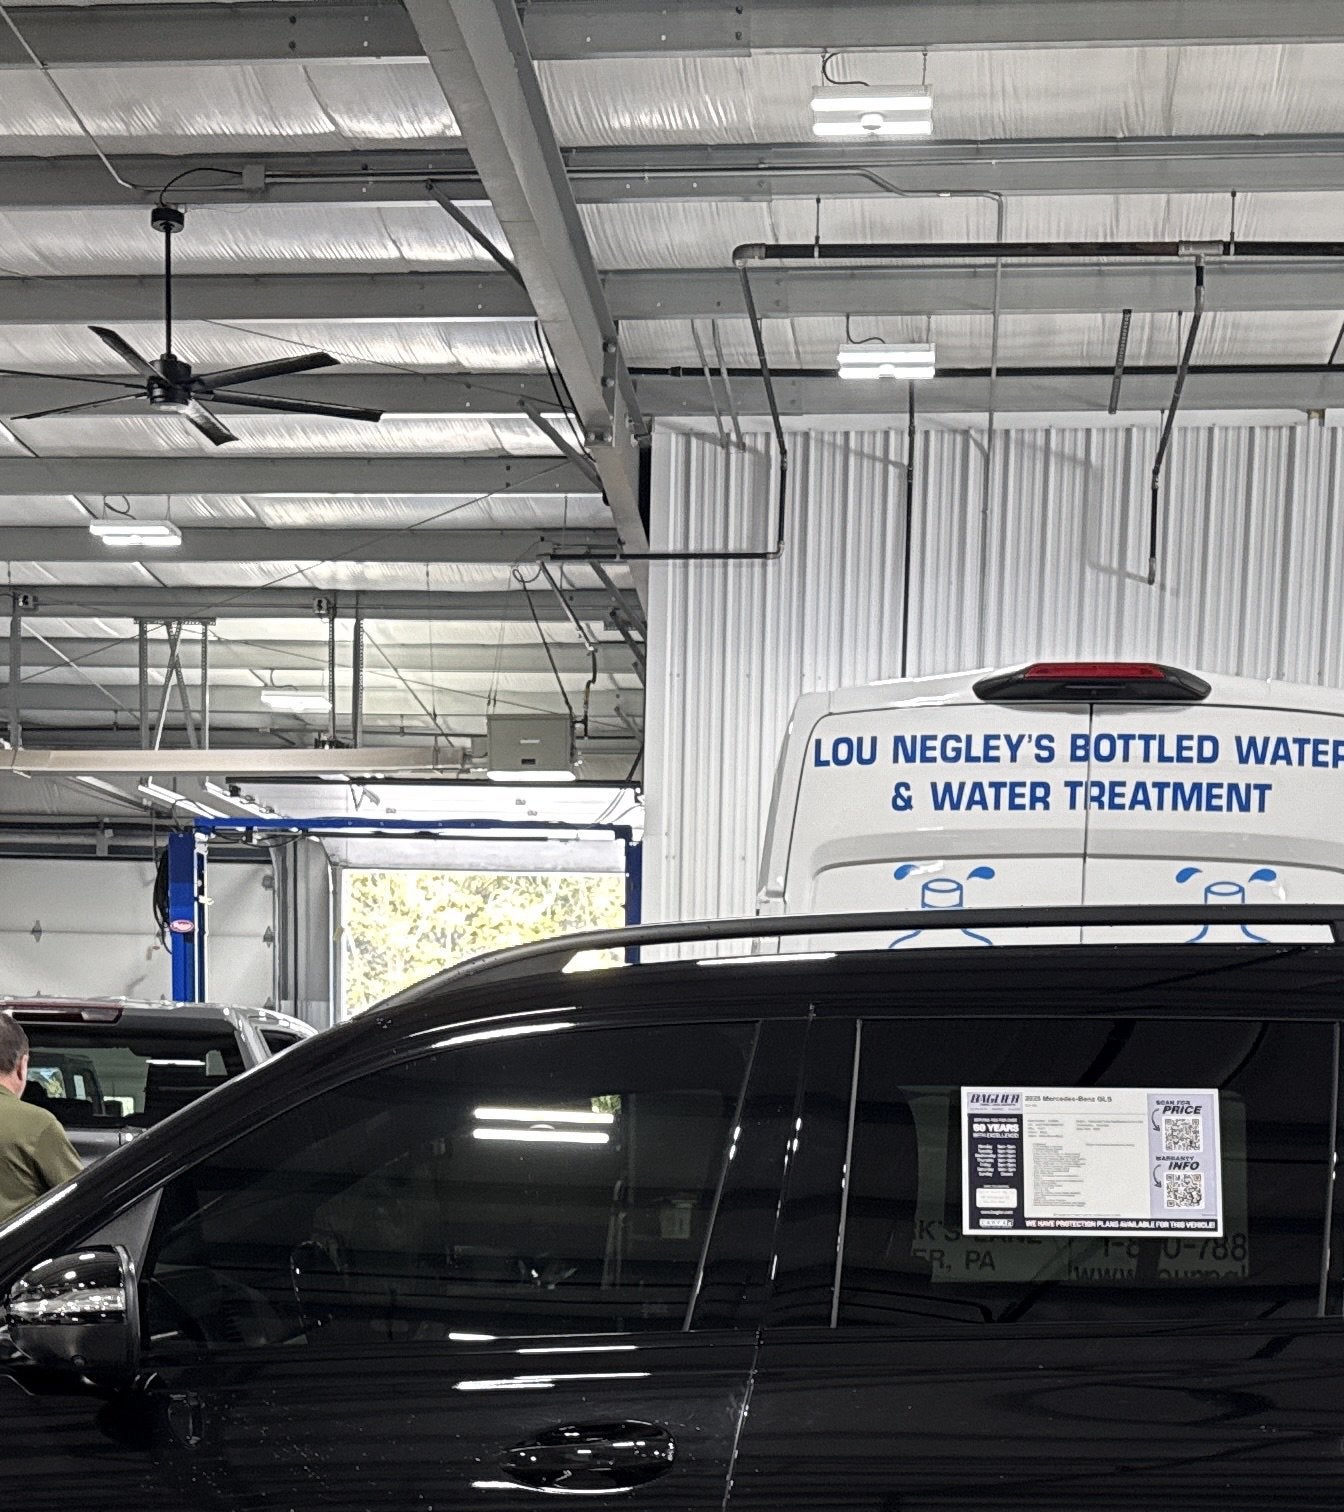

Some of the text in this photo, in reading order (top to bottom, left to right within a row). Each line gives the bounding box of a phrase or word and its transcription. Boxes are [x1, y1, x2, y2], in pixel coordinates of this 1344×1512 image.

[814, 736, 877, 767] LOU
[892, 734, 1055, 764] NEGLEY'S
[1069, 733, 1219, 764] BOTTLED
[891, 780, 1272, 813] & WATER TREATMENT
[1162, 1105, 1203, 1115] PRICE
[1168, 1161, 1200, 1171] INFO
[965, 1250, 996, 1271] PA
